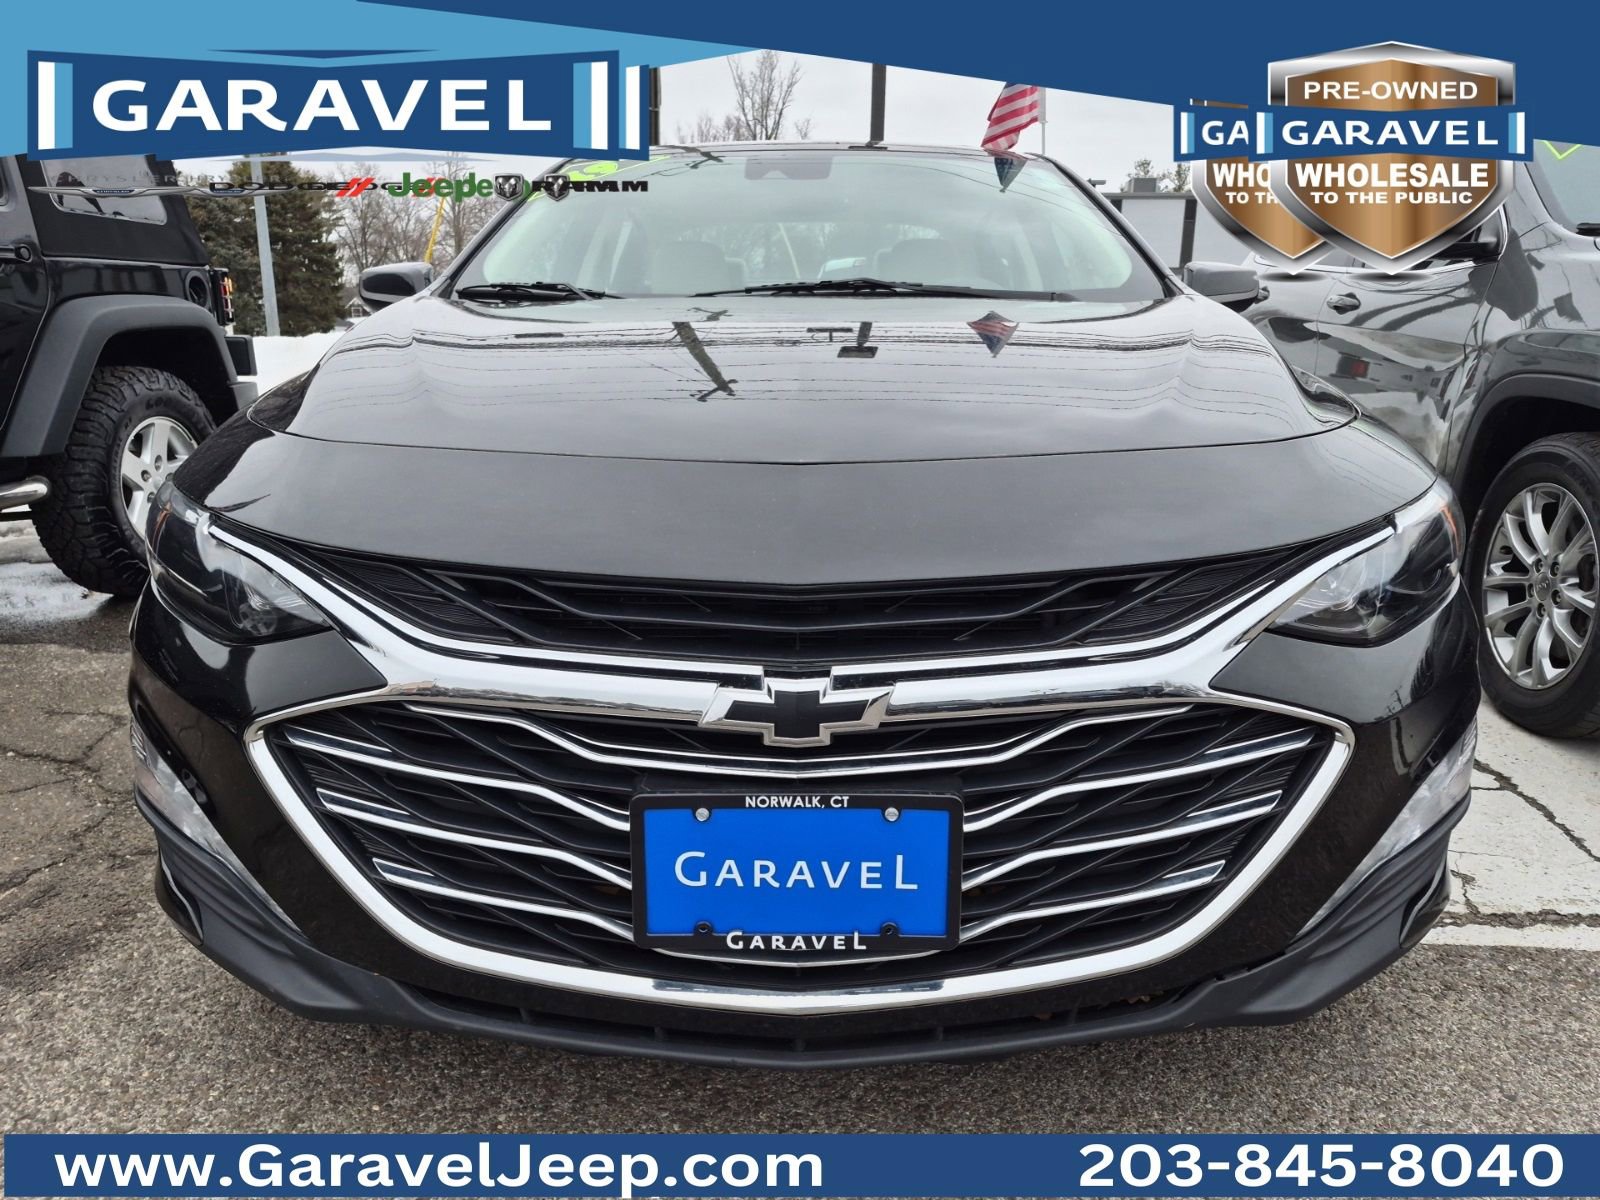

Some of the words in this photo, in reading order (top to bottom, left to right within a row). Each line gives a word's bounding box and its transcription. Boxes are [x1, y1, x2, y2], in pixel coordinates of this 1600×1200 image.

[745, 795, 826, 809] NORWALK,
[829, 796, 849, 808] CT
[674, 851, 918, 890] GARAVEL
[726, 931, 867, 951] GARAVEL
